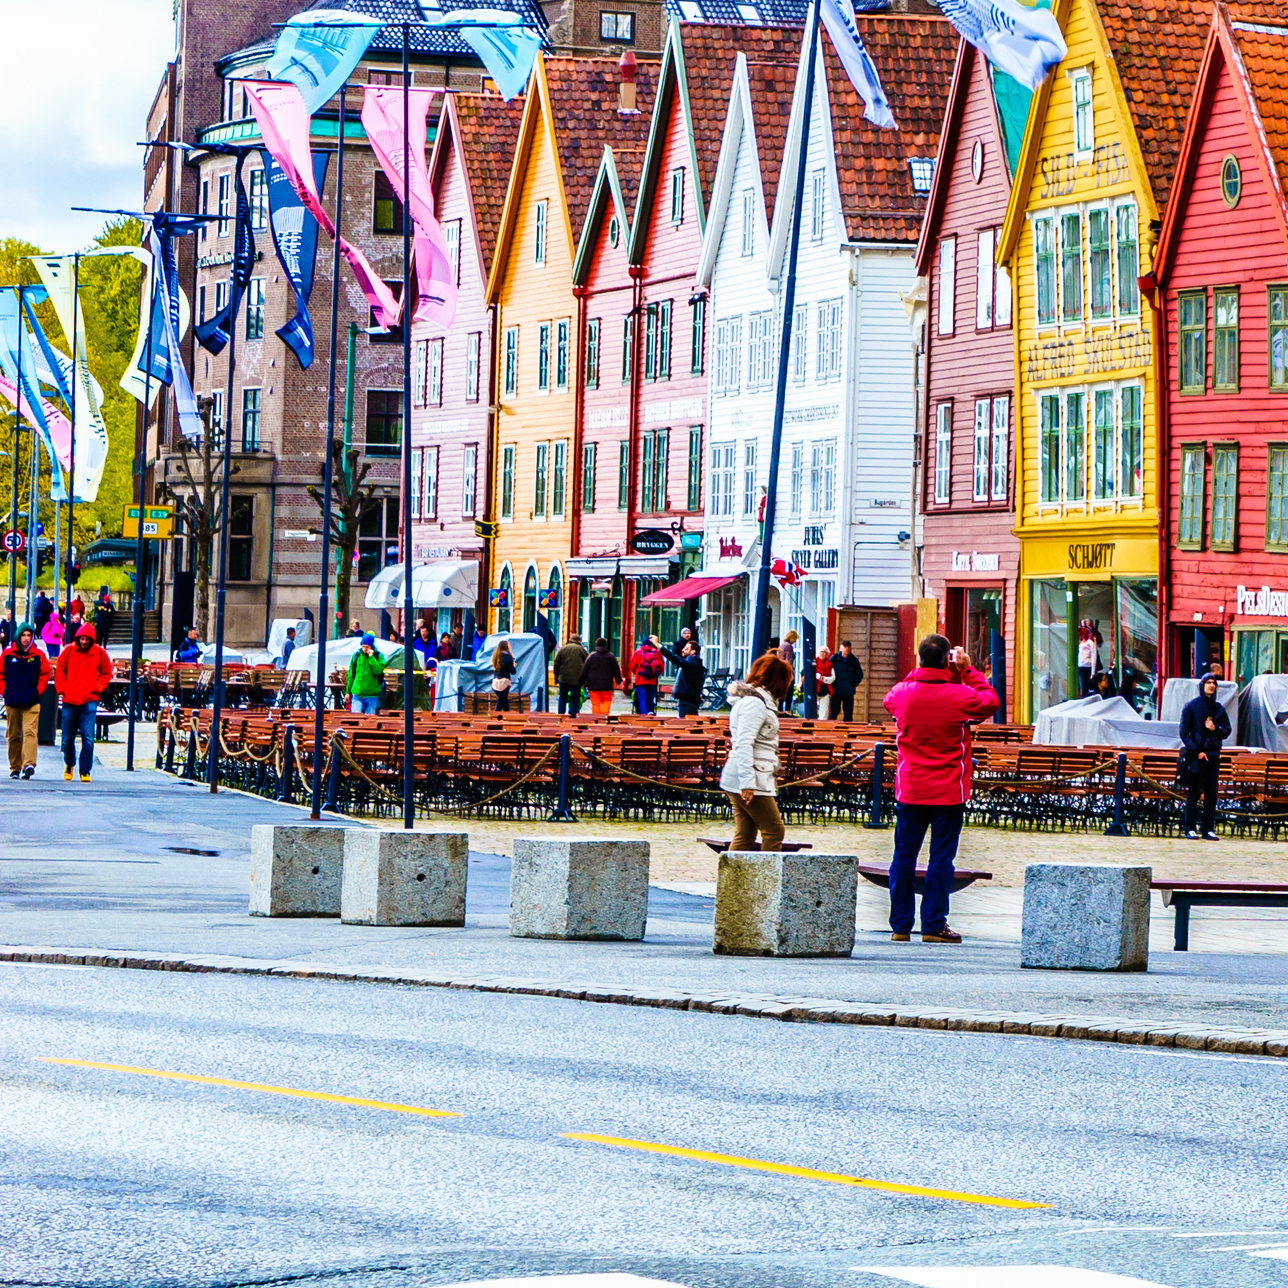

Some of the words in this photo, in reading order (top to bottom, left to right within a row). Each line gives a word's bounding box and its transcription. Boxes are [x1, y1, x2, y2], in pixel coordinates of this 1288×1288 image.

[1027, 340, 1075, 381] ALFRED
[1084, 328, 1152, 374] SKULSTAD
[6, 535, 21, 546] 50
[1068, 542, 1116, 570] SCHJØTT
